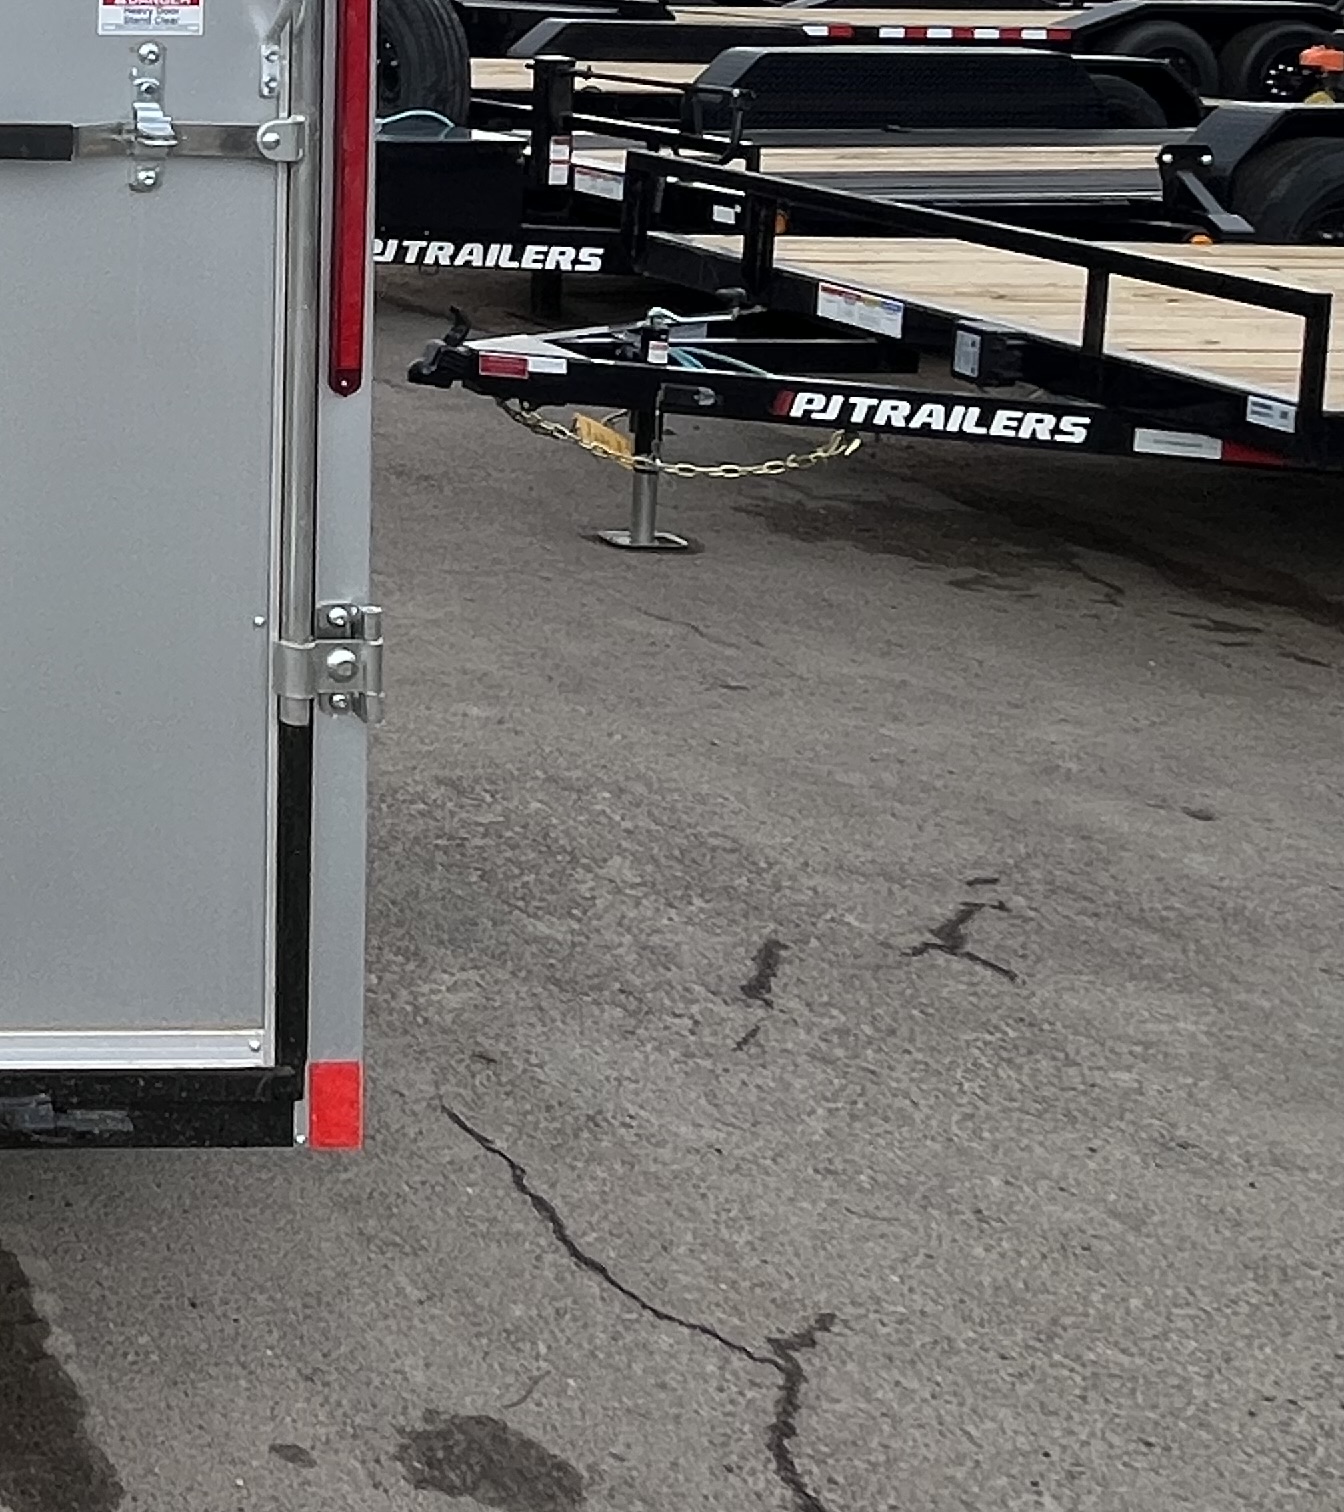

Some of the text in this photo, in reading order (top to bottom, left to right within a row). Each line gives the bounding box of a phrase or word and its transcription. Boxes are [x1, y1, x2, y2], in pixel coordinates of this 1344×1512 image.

[402, 240, 605, 271] TRAILERS
[790, 392, 1091, 443] PJ TRAILERS
